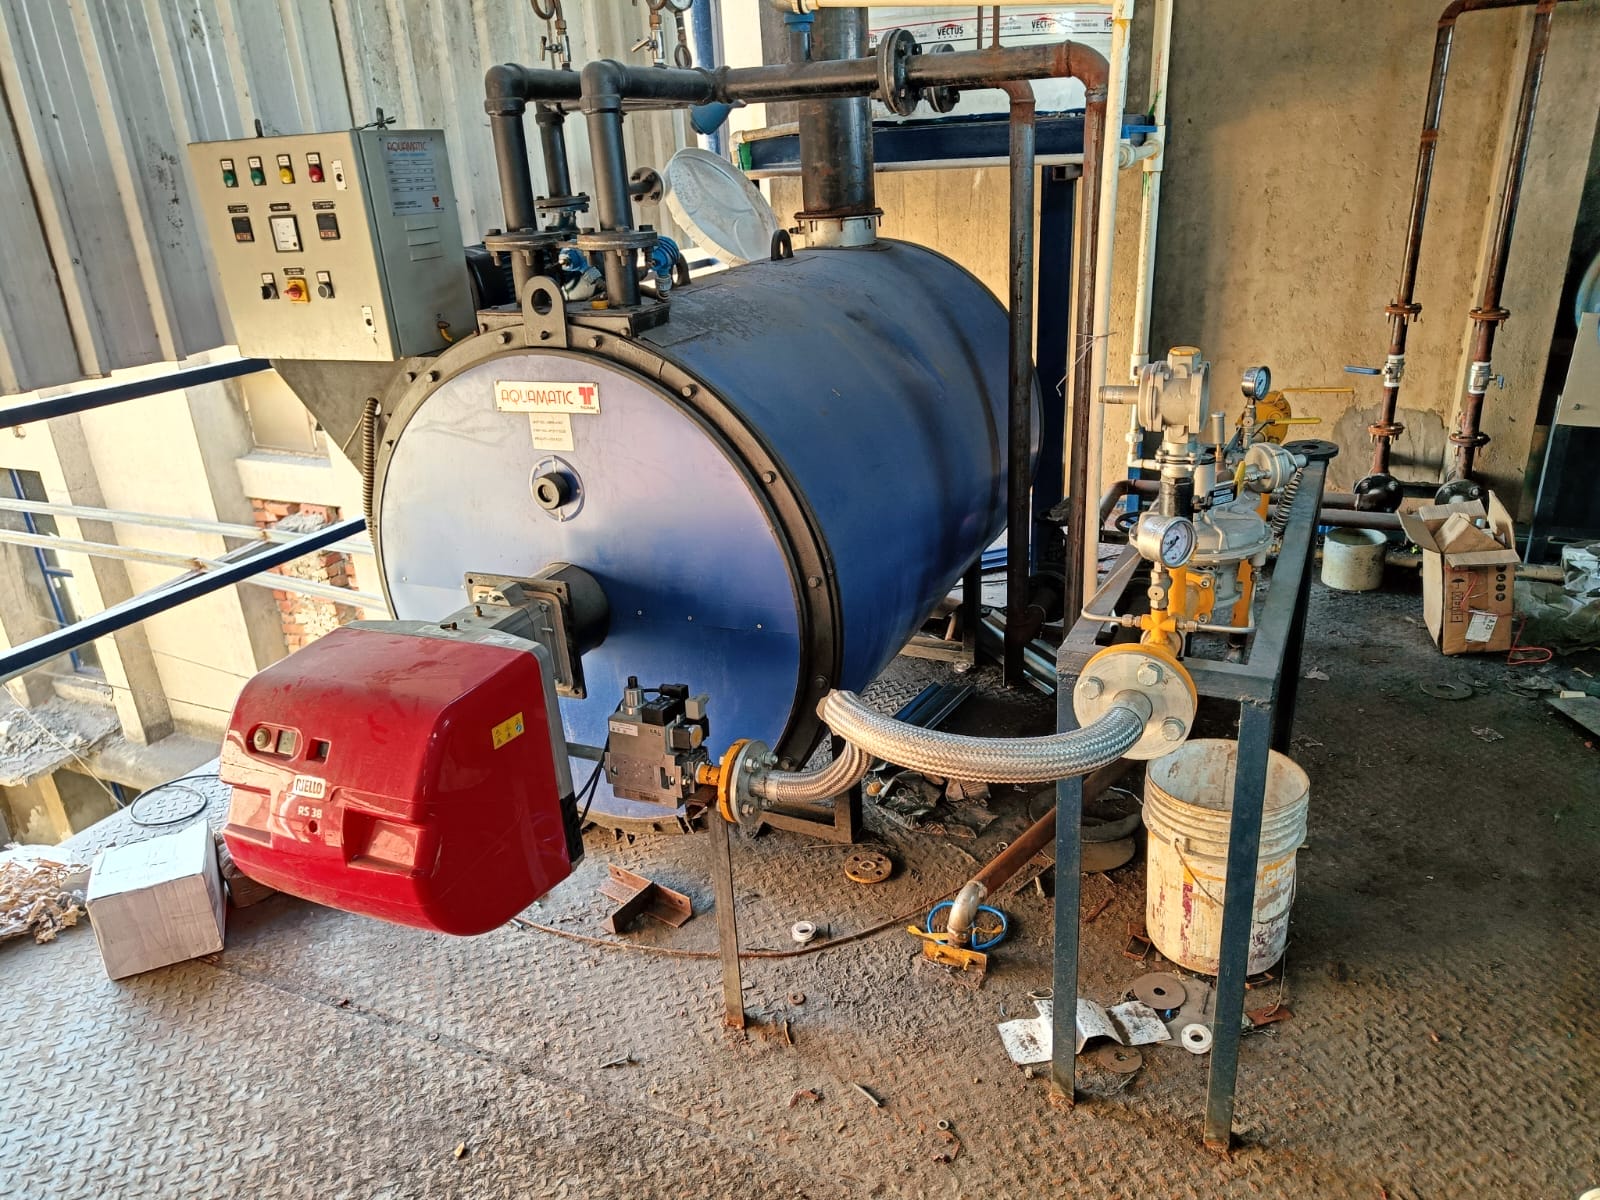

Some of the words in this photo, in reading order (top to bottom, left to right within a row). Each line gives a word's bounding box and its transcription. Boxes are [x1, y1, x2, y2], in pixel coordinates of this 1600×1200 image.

[937, 26, 964, 36] VECTUS
[501, 389, 573, 405] AQUAMATIC
[295, 778, 323, 795] RIELLO
[298, 805, 309, 817] RS
[311, 807, 322, 819] 38
